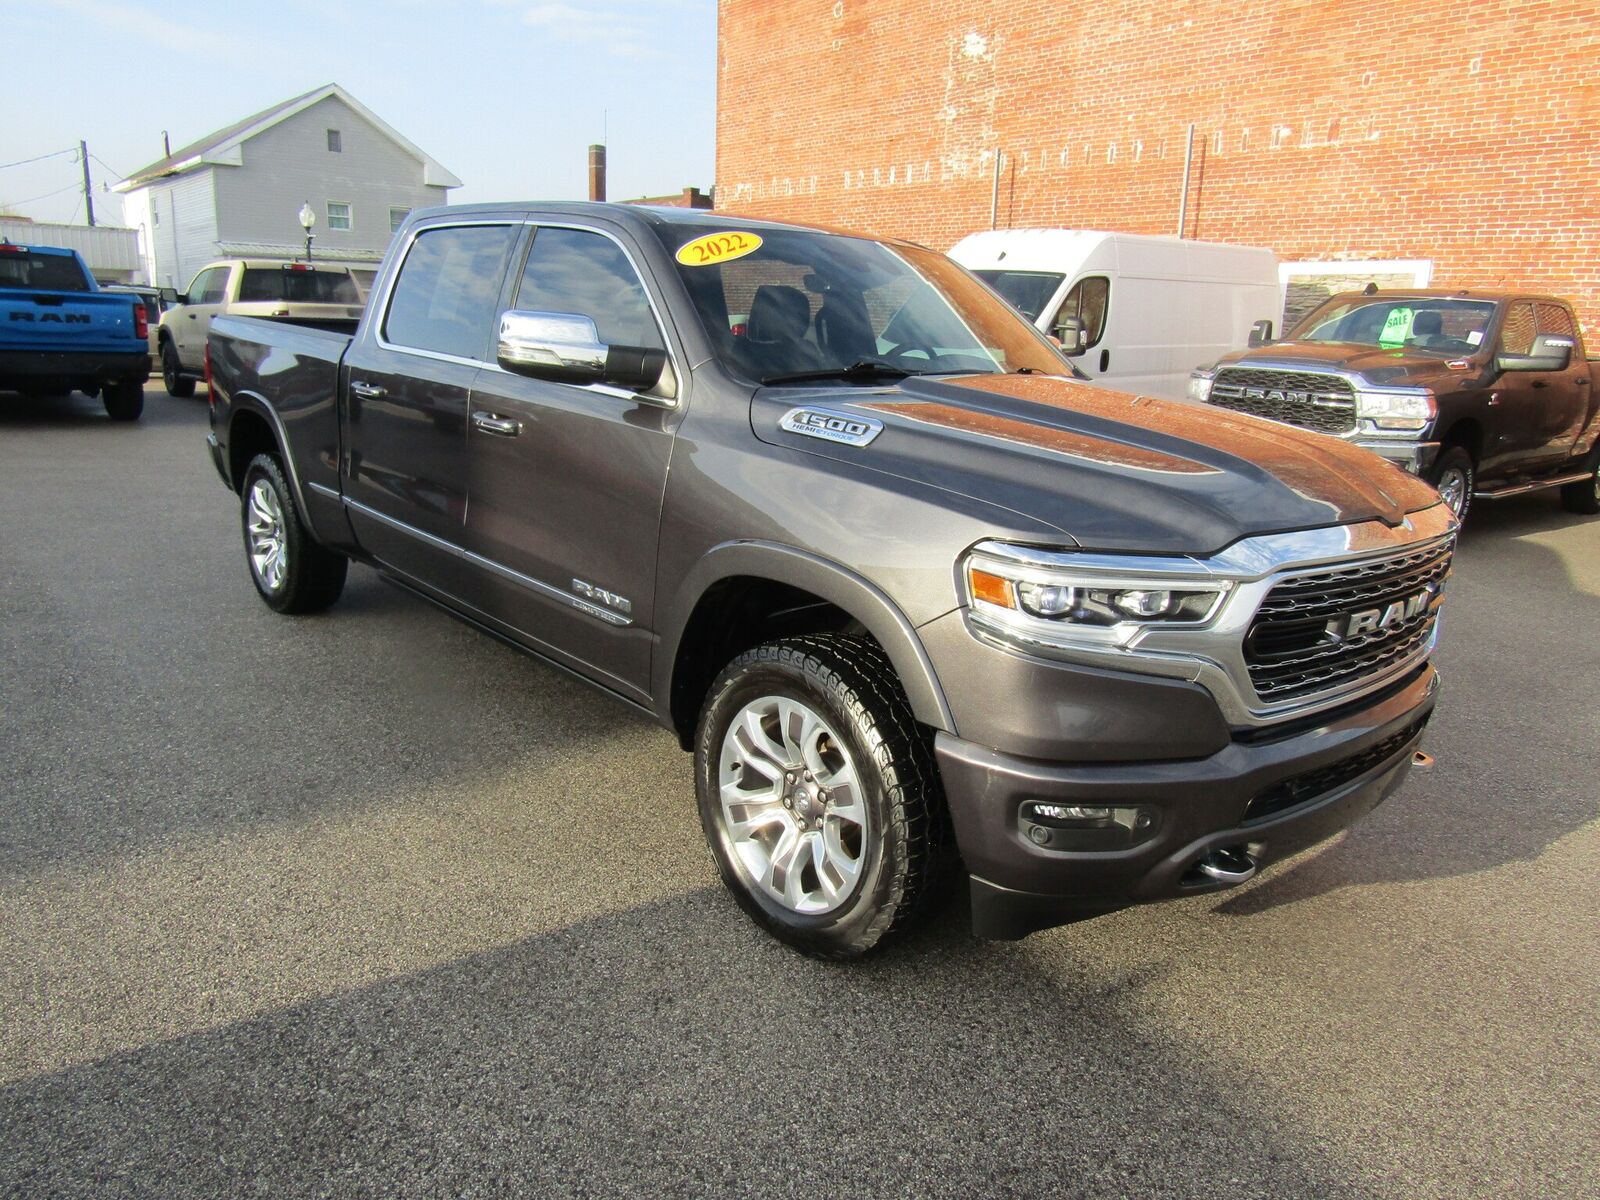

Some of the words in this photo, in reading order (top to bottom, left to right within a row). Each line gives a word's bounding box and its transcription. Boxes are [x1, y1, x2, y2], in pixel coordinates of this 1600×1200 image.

[693, 234, 748, 262] 2022
[9, 311, 91, 324] RAM
[1387, 314, 1409, 328] SALE
[1246, 387, 1308, 402] RAM
[792, 423, 816, 433] HEMI
[799, 412, 867, 436] 1500
[572, 578, 632, 613] RAM
[1346, 591, 1430, 637] RAM
